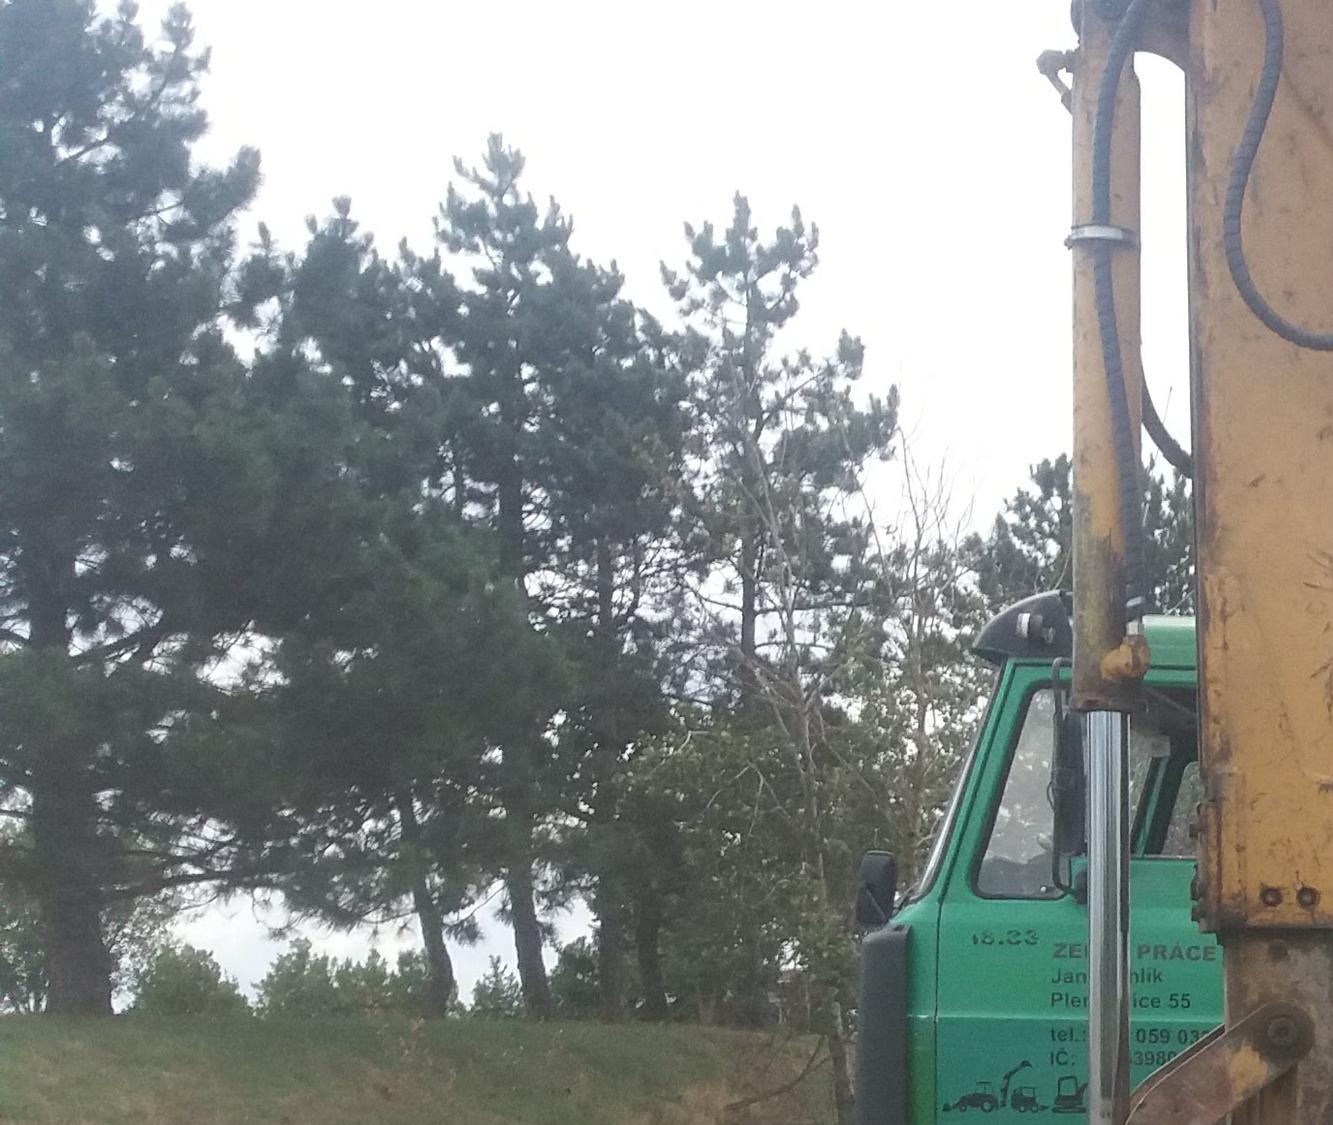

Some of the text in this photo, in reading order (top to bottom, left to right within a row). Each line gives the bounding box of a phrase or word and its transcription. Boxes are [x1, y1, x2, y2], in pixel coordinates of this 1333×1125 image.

[1053, 941, 1217, 961] ZE PRÁCE
[1051, 967, 1088, 984] Jan
[1168, 993, 1191, 1009] 55
[1050, 1026, 1087, 1043] tel.:
[1136, 1028, 1170, 1044] 059
